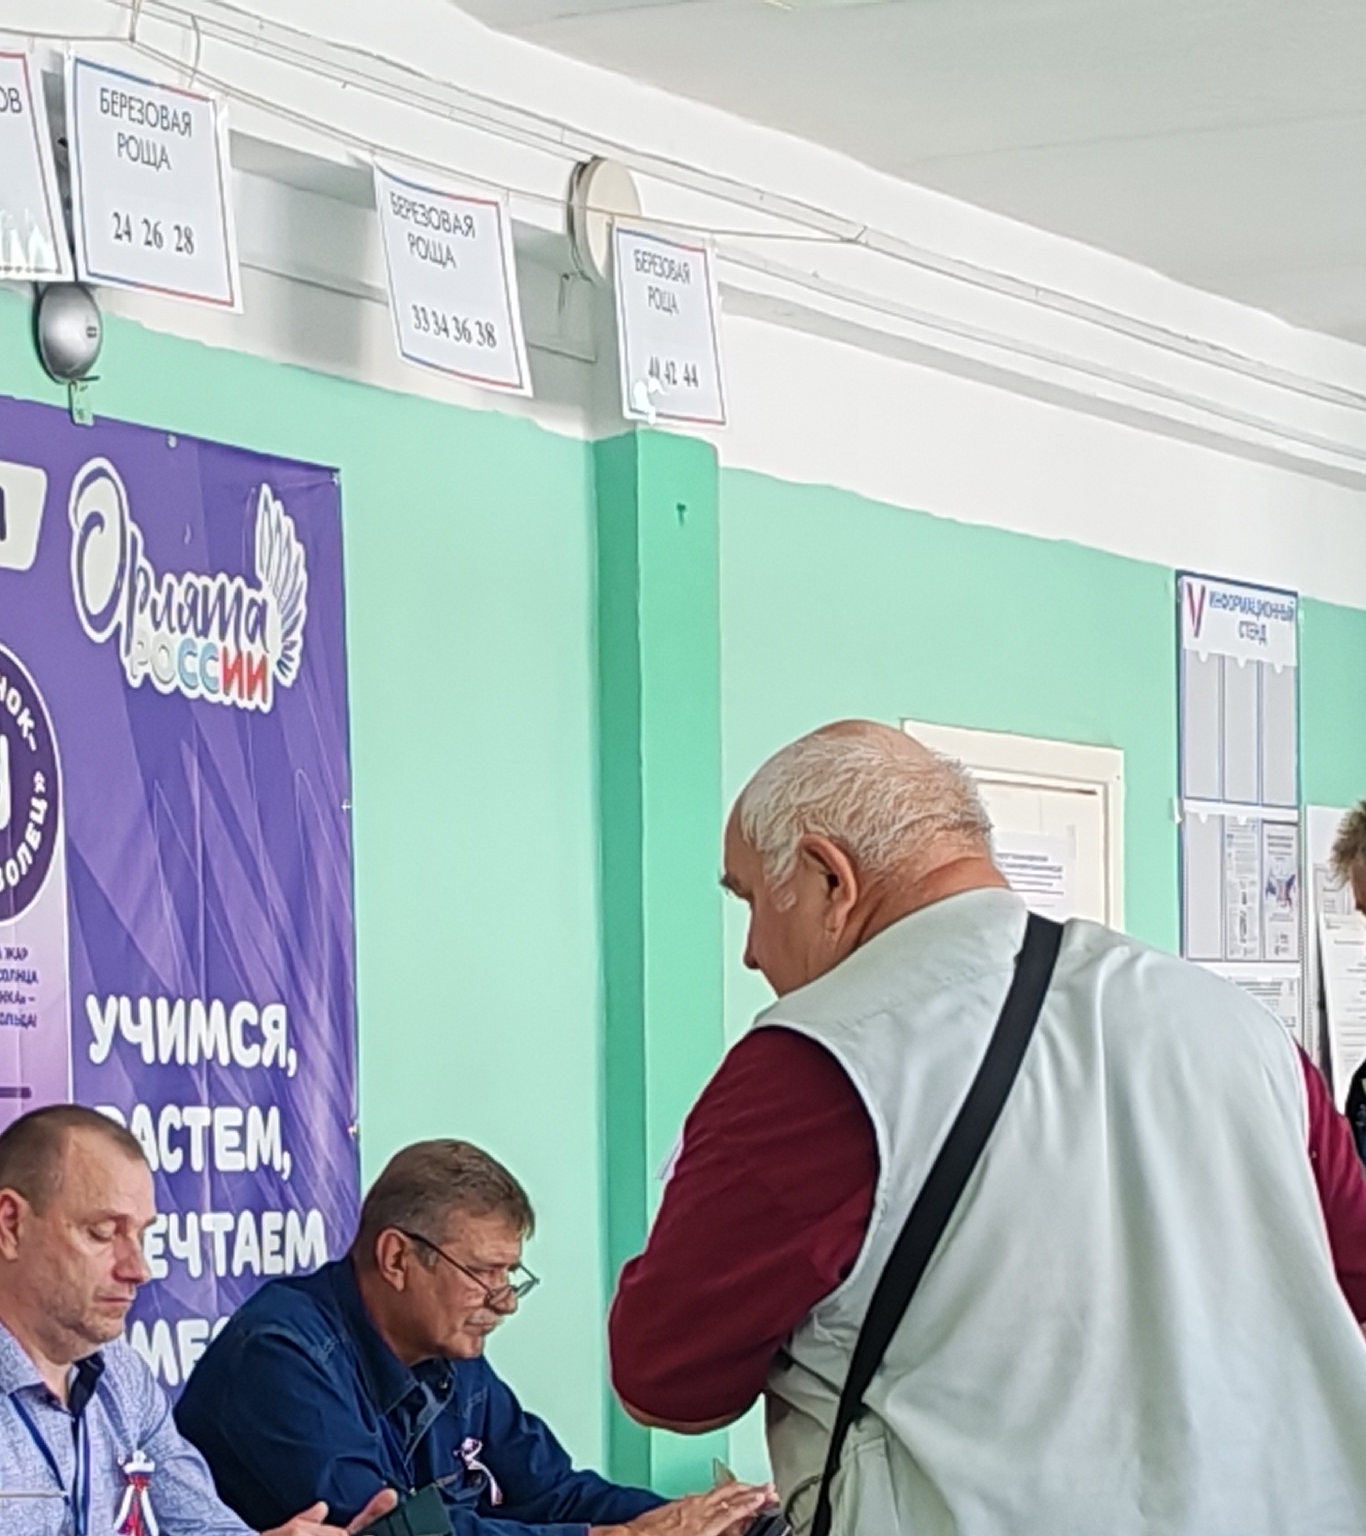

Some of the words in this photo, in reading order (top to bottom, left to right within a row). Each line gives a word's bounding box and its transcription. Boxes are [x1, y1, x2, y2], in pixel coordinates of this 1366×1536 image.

[99, 87, 193, 138] БЕРЕЗОВАЯ
[117, 134, 171, 171] РОЩА
[112, 212, 133, 243] 24
[142, 217, 164, 249] 26
[173, 223, 195, 255] 28
[389, 190, 477, 239] БЕРЕЗОВАЯ
[407, 231, 457, 269] РОЩА
[634, 249, 692, 285] БЕРЕЗОВАЯ
[647, 285, 679, 316] РОЩА
[85, 994, 298, 1078] УЧИМСЯ,
[144, 1209, 328, 1280] ЕЧТАЕМ
